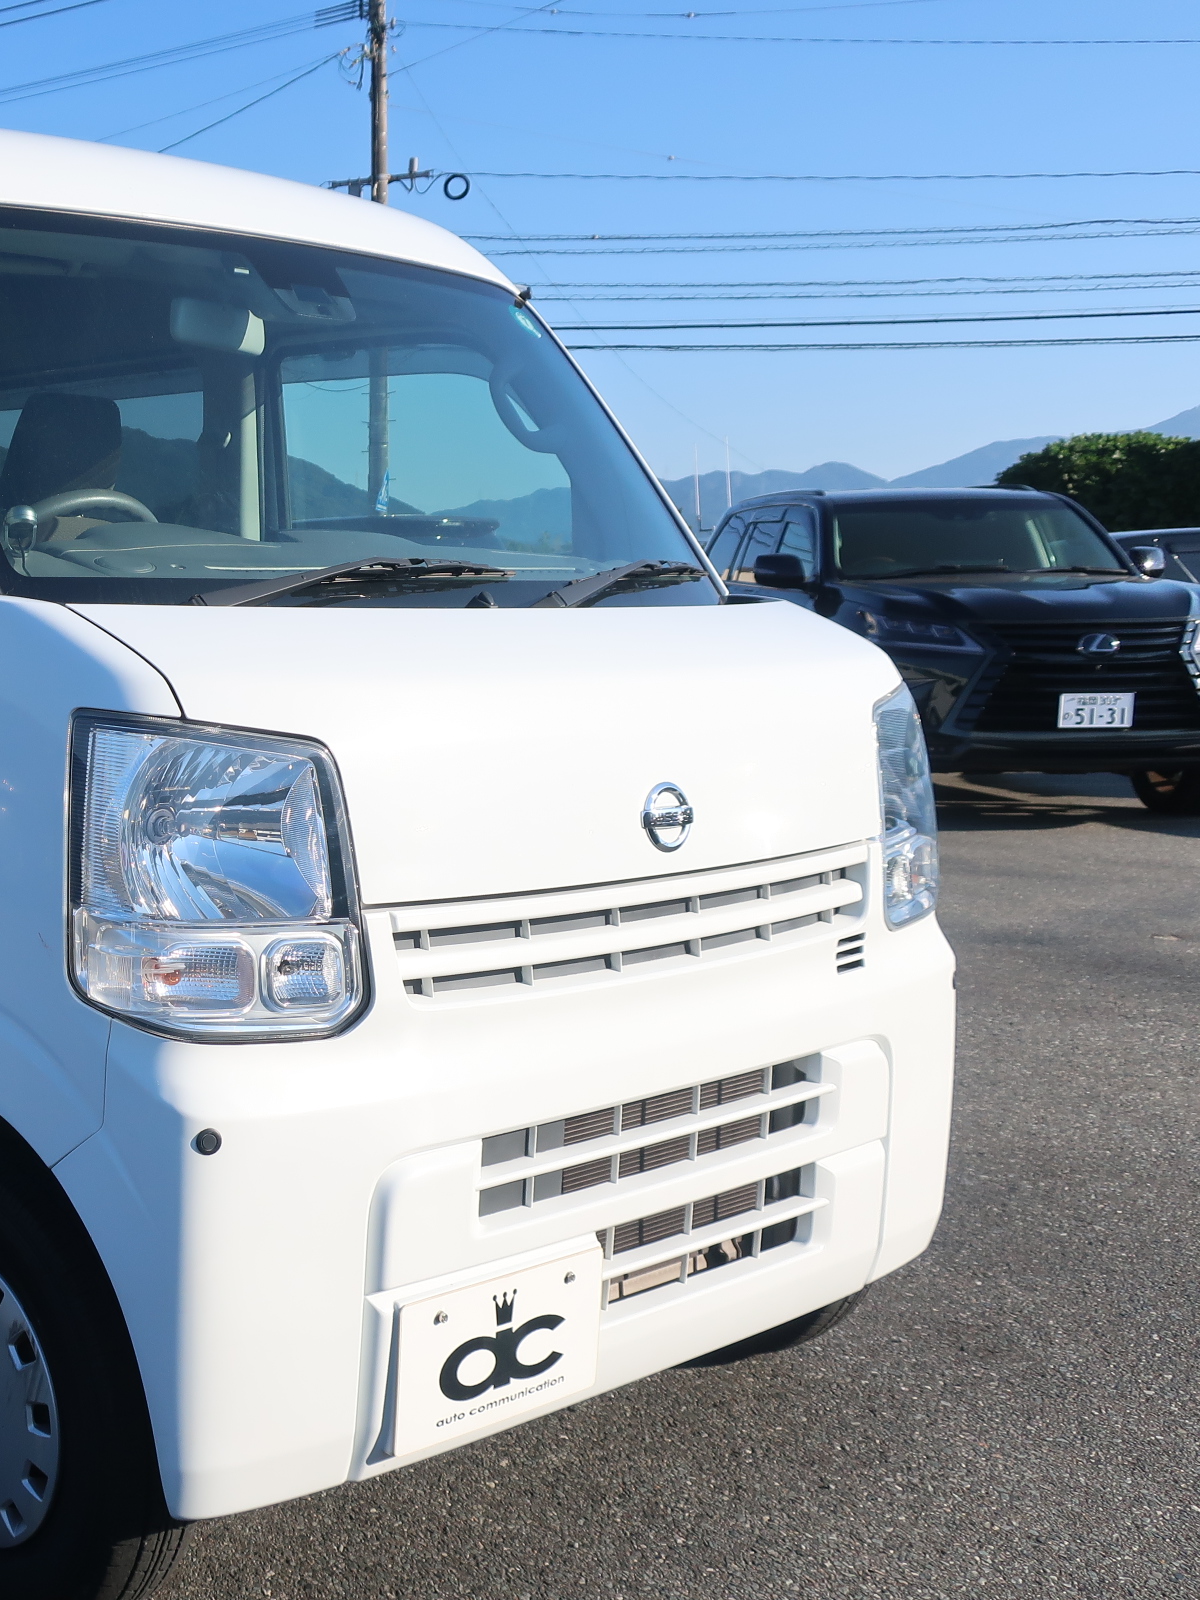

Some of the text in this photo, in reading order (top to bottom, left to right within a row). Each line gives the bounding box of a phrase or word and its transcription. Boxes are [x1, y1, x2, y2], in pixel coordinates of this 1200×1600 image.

[1074, 707, 1127, 725] 51-31
[436, 1375, 566, 1428] auto communication
